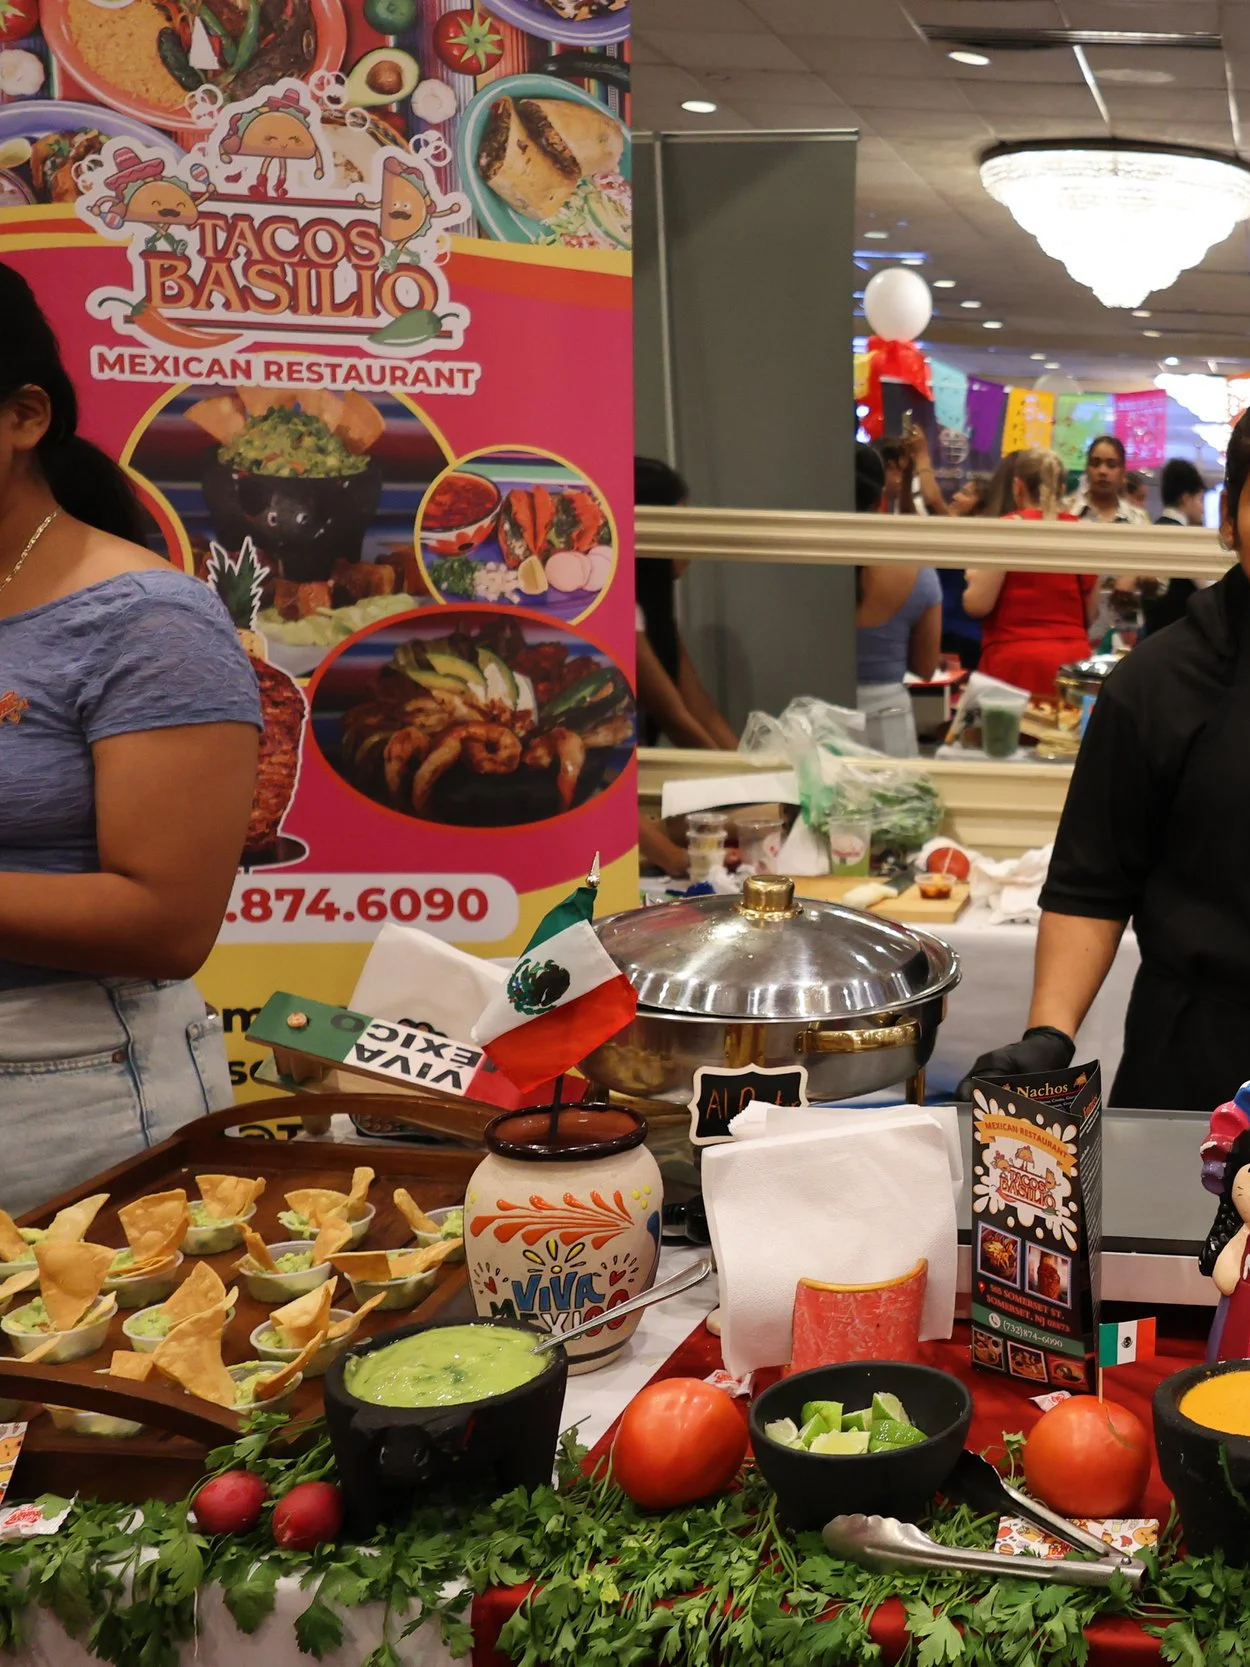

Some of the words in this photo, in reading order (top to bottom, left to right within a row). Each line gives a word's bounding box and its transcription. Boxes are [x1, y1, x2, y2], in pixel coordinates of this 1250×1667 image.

[195, 211, 384, 265] TACOS
[141, 250, 438, 320] BASILIO
[97, 352, 252, 382] MEXICAN
[263, 361, 475, 390] RESTAURANT
[354, 1042, 463, 1090] VIVA
[1016, 1082, 1069, 1099] Nachos
[984, 1121, 1019, 1134] MEXICAN
[1019, 1127, 1069, 1159] RESTAURANT
[1000, 1178, 1057, 1209] BASILIO
[1009, 1168, 1047, 1192] TACOS
